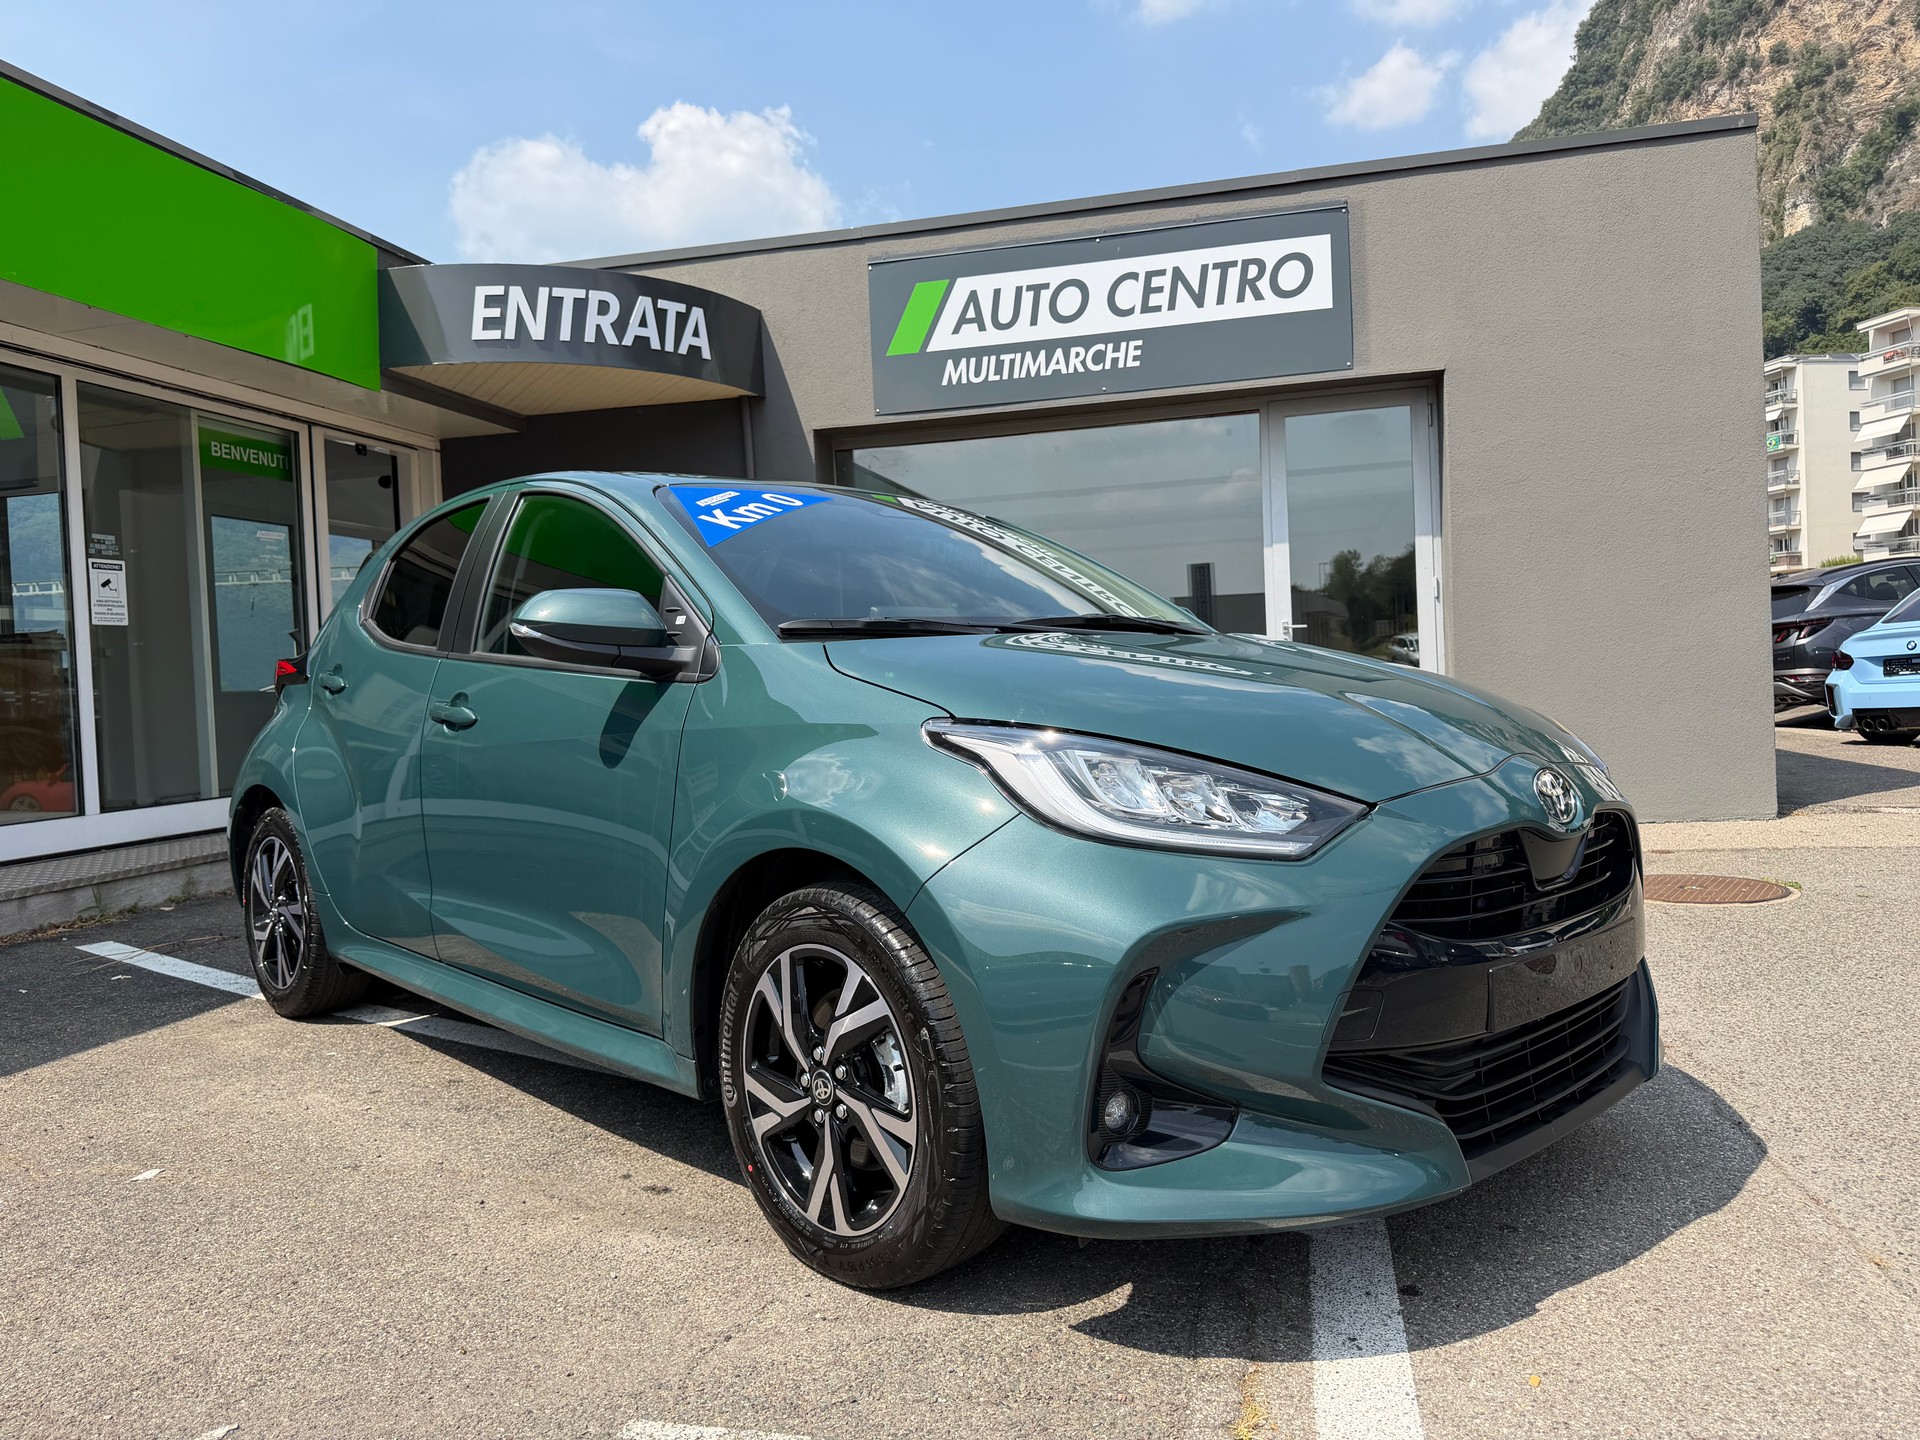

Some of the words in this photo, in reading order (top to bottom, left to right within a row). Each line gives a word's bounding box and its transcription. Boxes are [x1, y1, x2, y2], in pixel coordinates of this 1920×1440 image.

[471, 285, 712, 360] ENTRATA
[951, 278, 1090, 335] AUTO
[1106, 252, 1314, 318] CENTRO
[941, 339, 1144, 386] MULTIMARCHE
[211, 440, 289, 470] BENVENUTI
[697, 503, 784, 529] Km
[720, 982, 740, 1108] Continental
